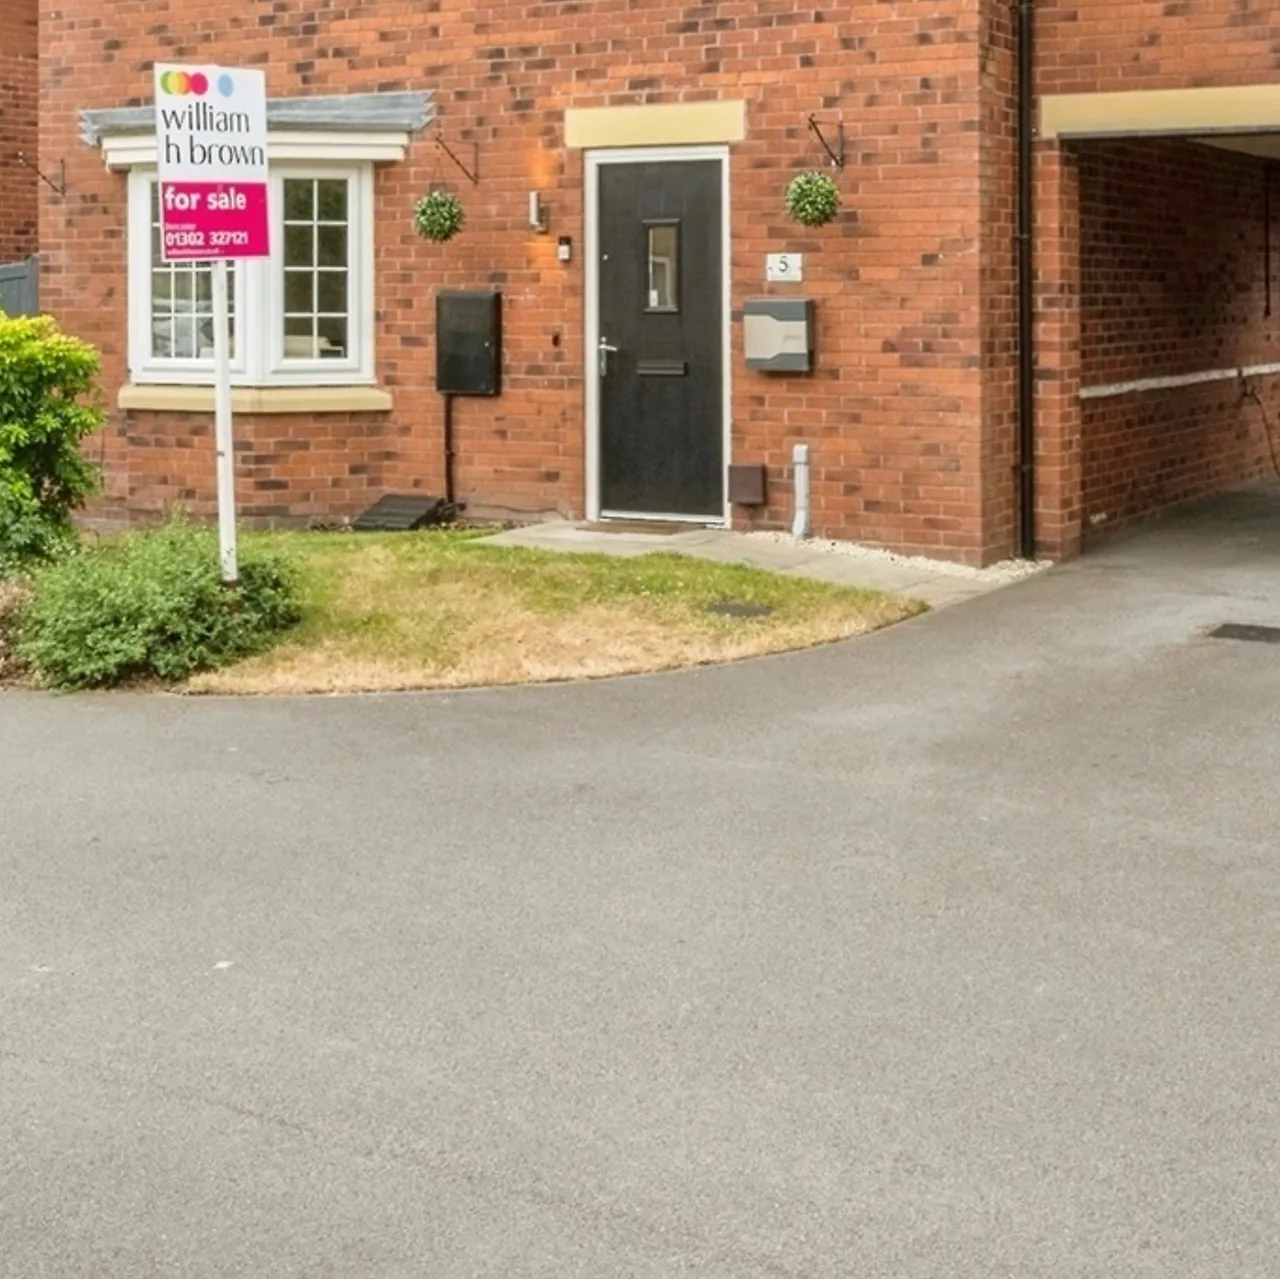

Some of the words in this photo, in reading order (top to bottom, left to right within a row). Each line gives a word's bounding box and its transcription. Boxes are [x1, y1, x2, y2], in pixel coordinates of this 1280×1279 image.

[161, 101, 250, 133] william
[166, 135, 181, 164] h
[189, 135, 265, 166] brown
[165, 185, 200, 210] for
[207, 186, 246, 210] sale
[165, 231, 204, 246] 01302
[209, 230, 249, 245] 327121
[778, 255, 790, 273] 5
